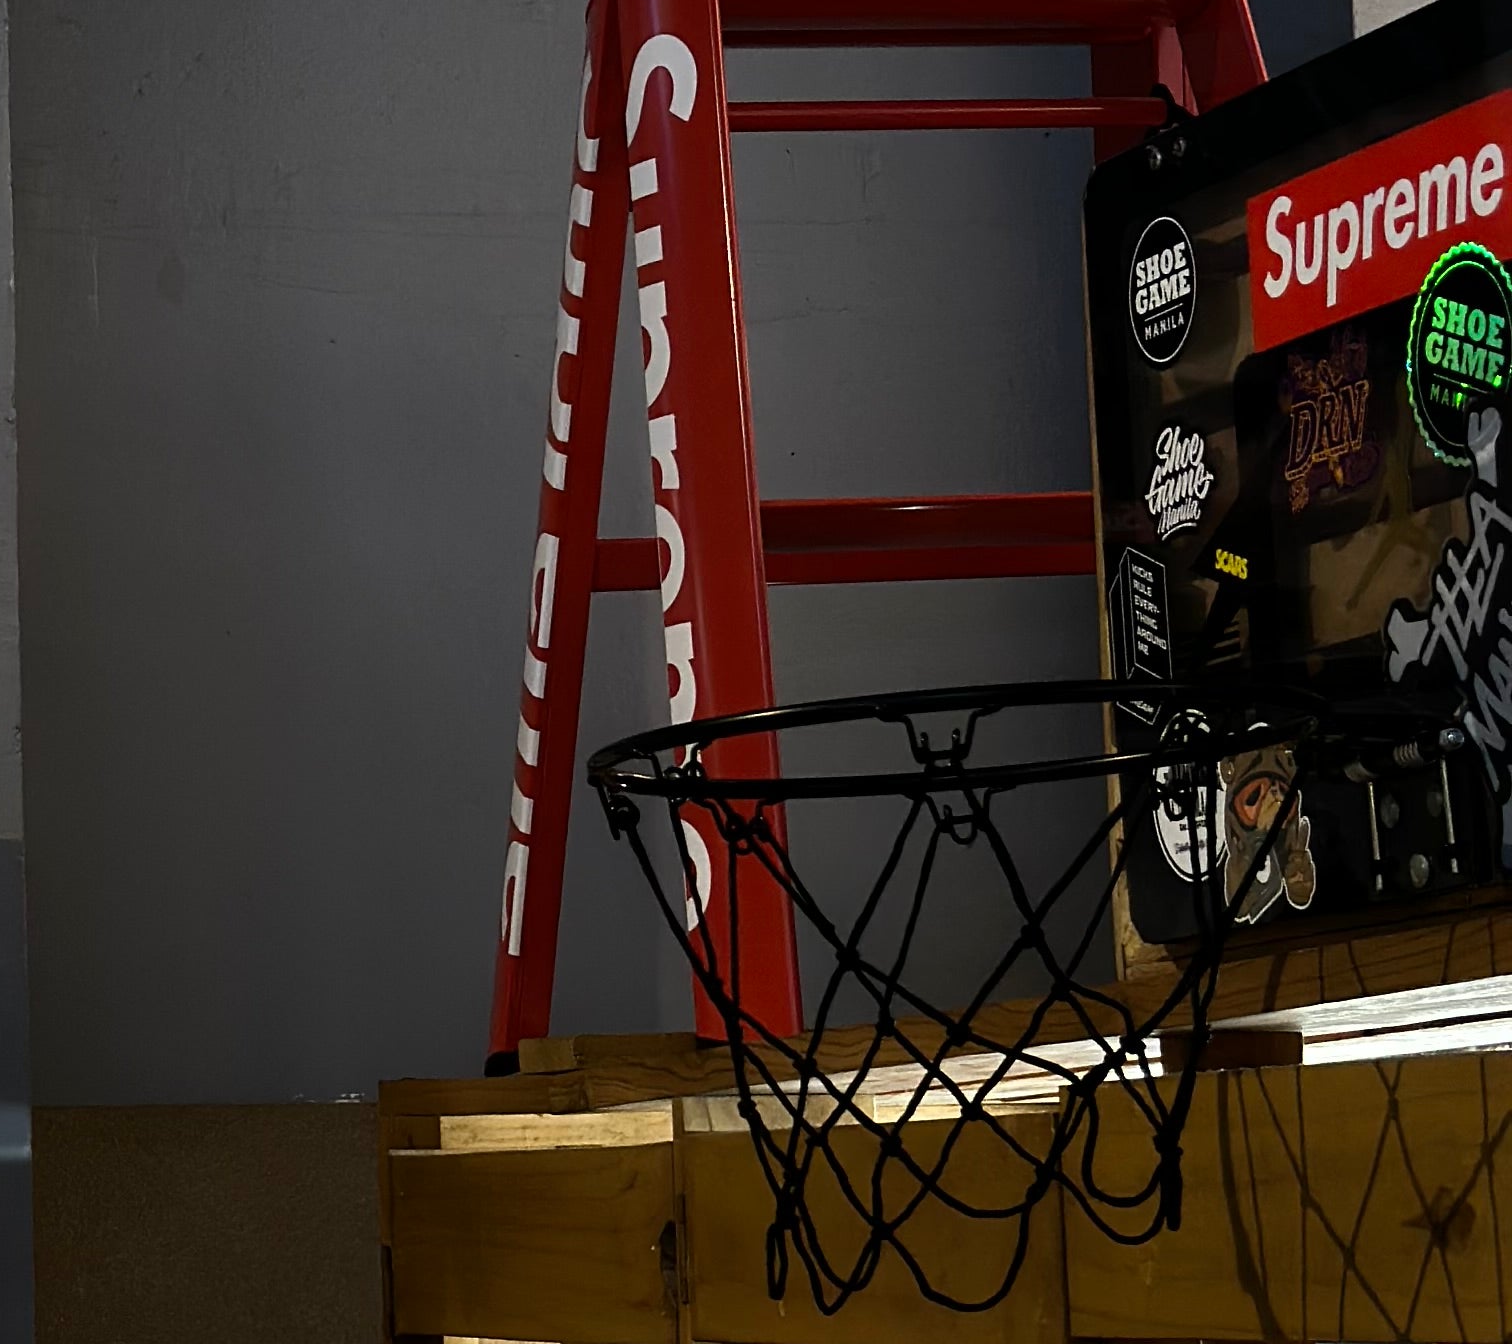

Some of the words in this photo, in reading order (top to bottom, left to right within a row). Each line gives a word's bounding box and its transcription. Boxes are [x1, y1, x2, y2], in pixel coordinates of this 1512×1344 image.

[1263, 143, 1504, 307] Supreme
[1136, 241, 1187, 288] SHOE
[1135, 267, 1192, 315] GAME
[1144, 311, 1185, 341] MANILA
[1431, 296, 1506, 349] SHOE
[1424, 331, 1506, 389] GAME
[1156, 425, 1204, 476] Shoe
[1144, 462, 1215, 515] Game
